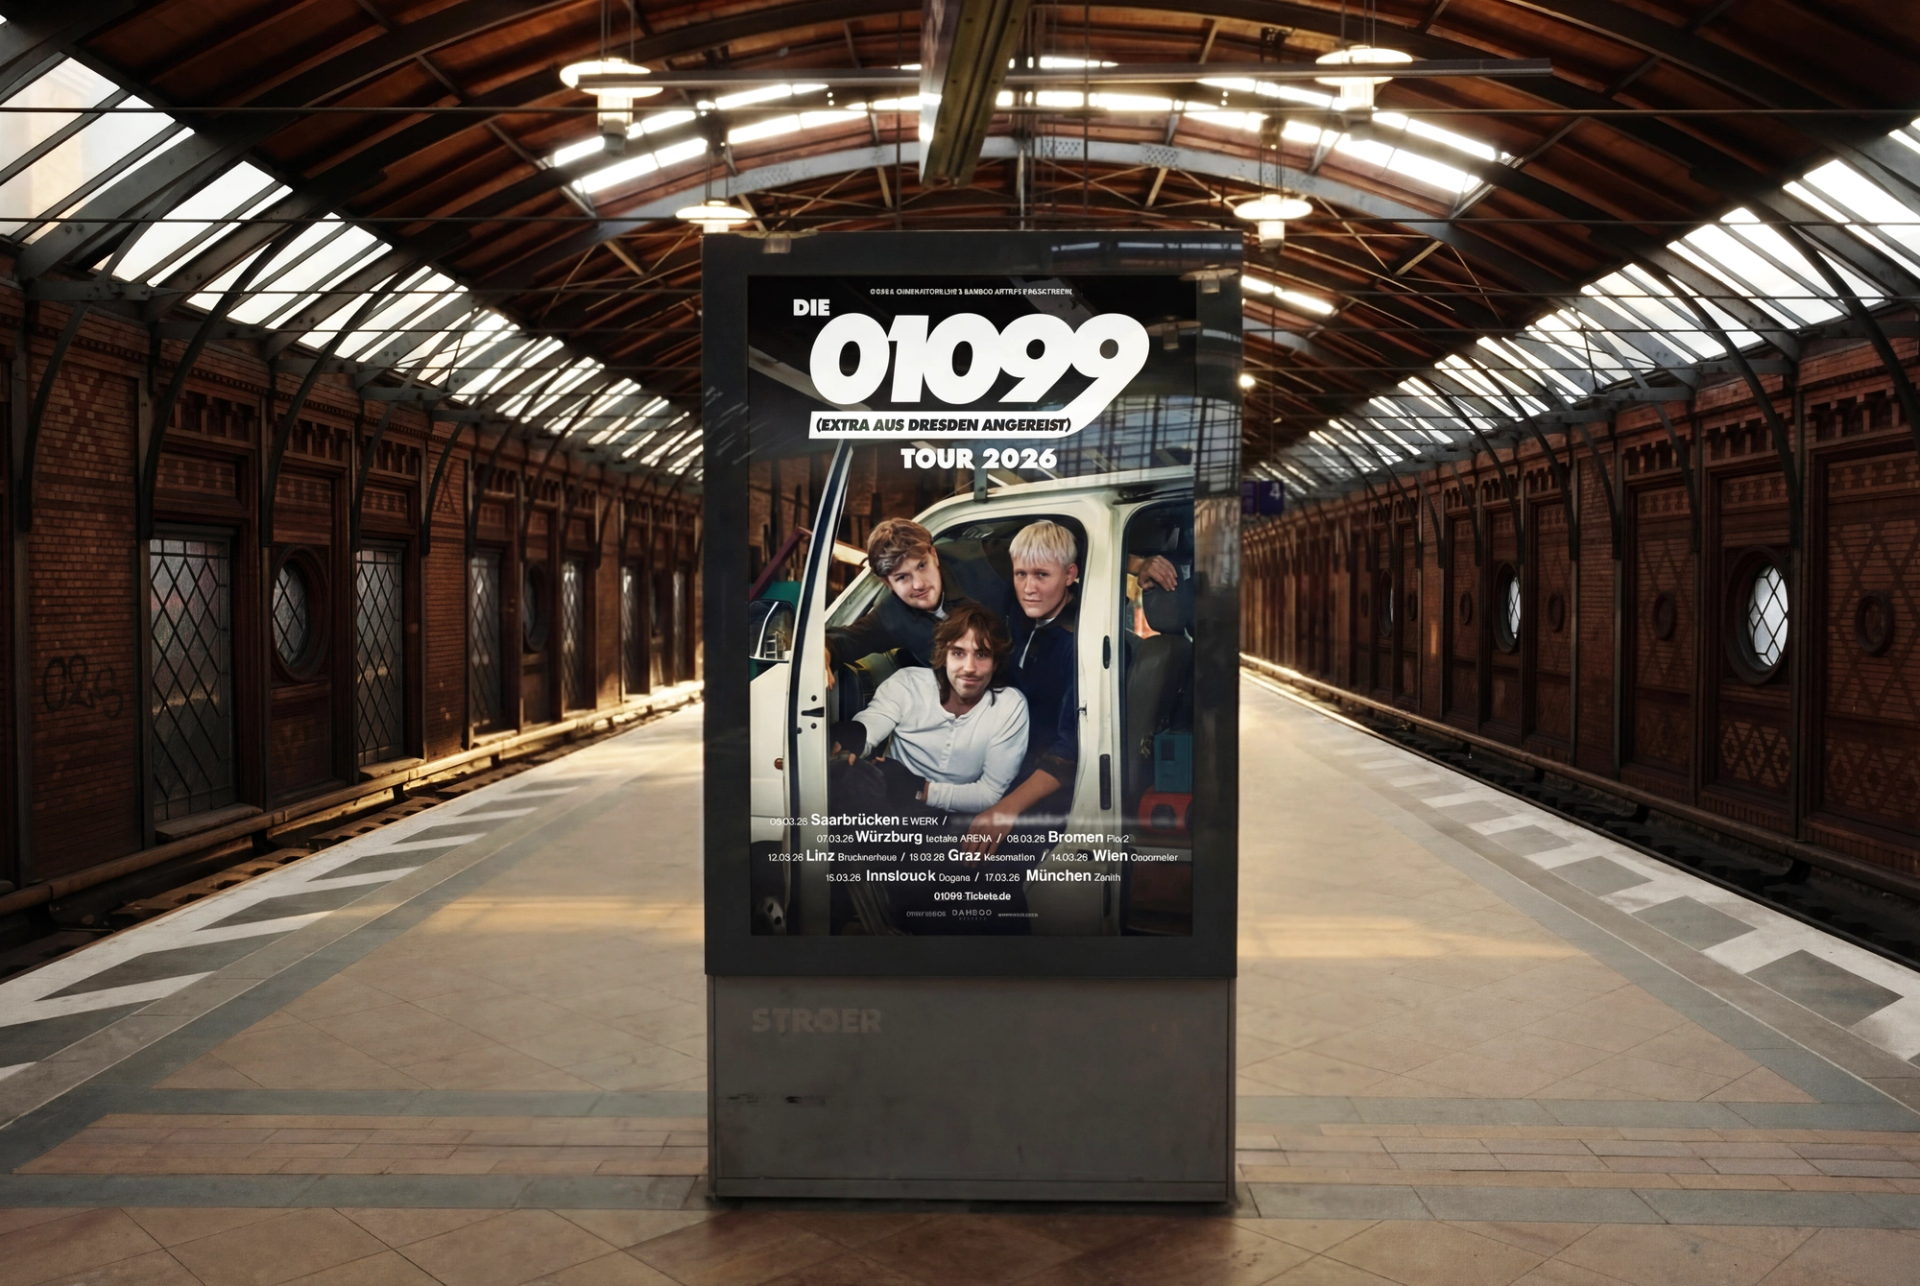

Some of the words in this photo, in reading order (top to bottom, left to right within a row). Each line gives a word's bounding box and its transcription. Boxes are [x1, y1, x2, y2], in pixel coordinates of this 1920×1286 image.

[793, 299, 830, 316] DIE
[809, 312, 1150, 406] 01099
[815, 417, 871, 433] (EXTRA
[873, 418, 905, 432] AUS
[907, 418, 979, 432] DRESDEN
[981, 417, 1072, 433] ANGEREIST)
[901, 448, 975, 470] TOUR
[981, 448, 1057, 470] 2026
[1269, 482, 1281, 500] 4
[810, 813, 900, 826] Saarbrücken
[902, 816, 909, 826] E
[910, 816, 939, 826] WERK
[855, 830, 923, 845] Würzburg
[959, 833, 993, 843] ARENA
[806, 849, 835, 862] Linz
[948, 848, 982, 862] Graz
[1093, 849, 1129, 862] Wien
[1026, 869, 1092, 882] München
